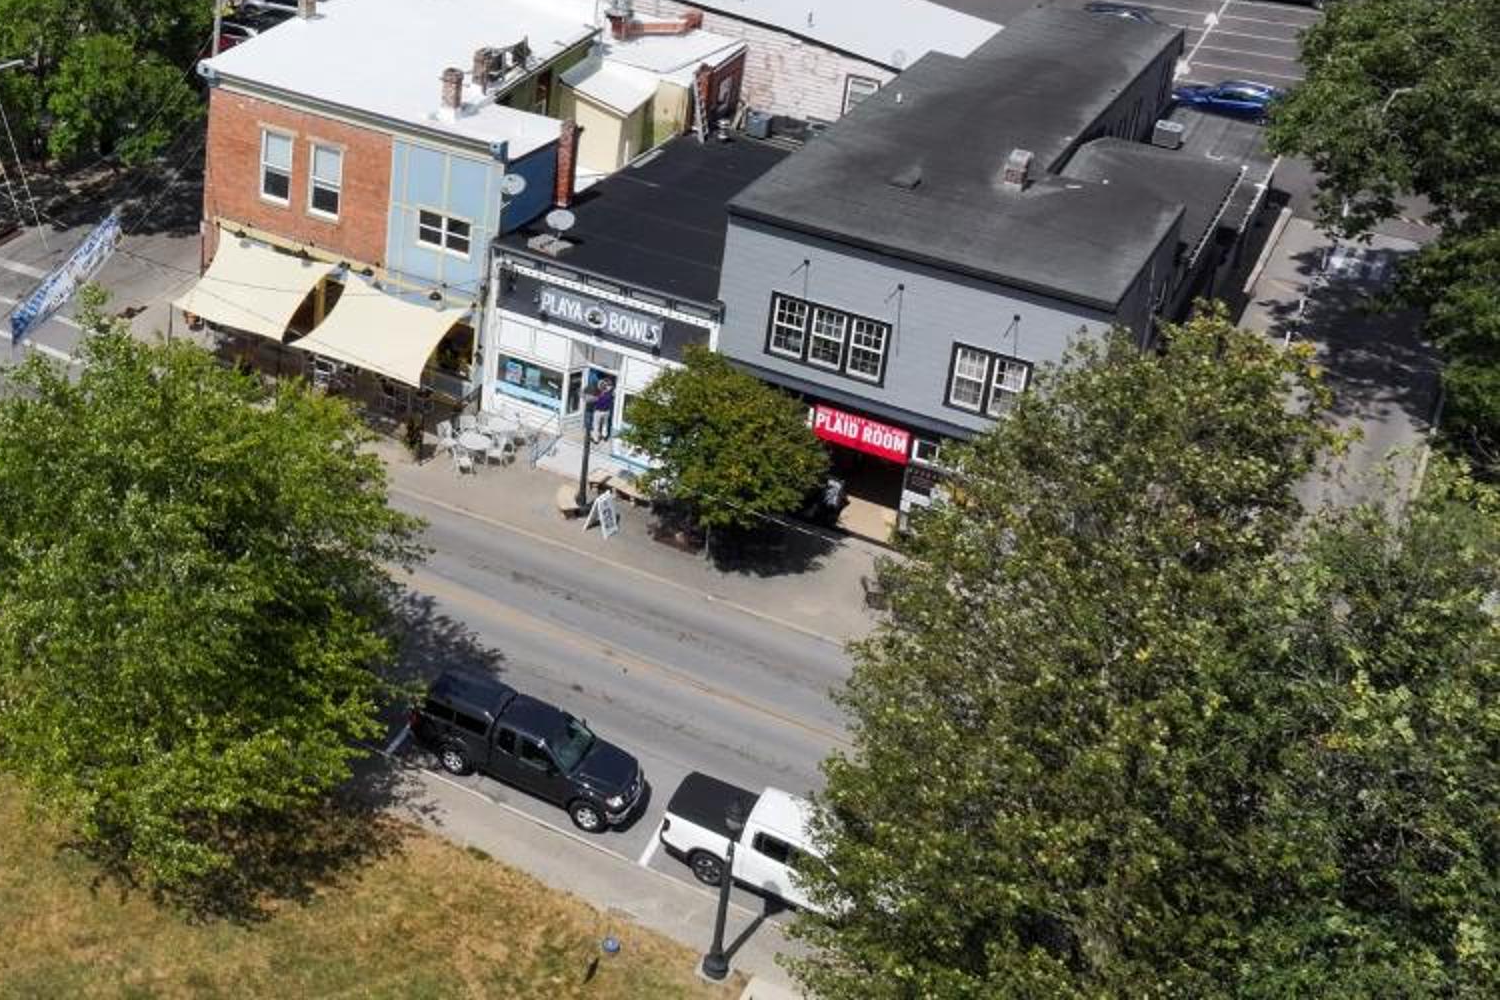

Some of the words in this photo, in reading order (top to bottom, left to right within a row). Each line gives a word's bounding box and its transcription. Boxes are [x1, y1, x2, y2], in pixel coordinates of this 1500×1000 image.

[540, 291, 583, 321] PLAYA
[608, 312, 660, 345] BOWLS
[815, 412, 859, 439] PLAID
[862, 425, 907, 455] ROOM
